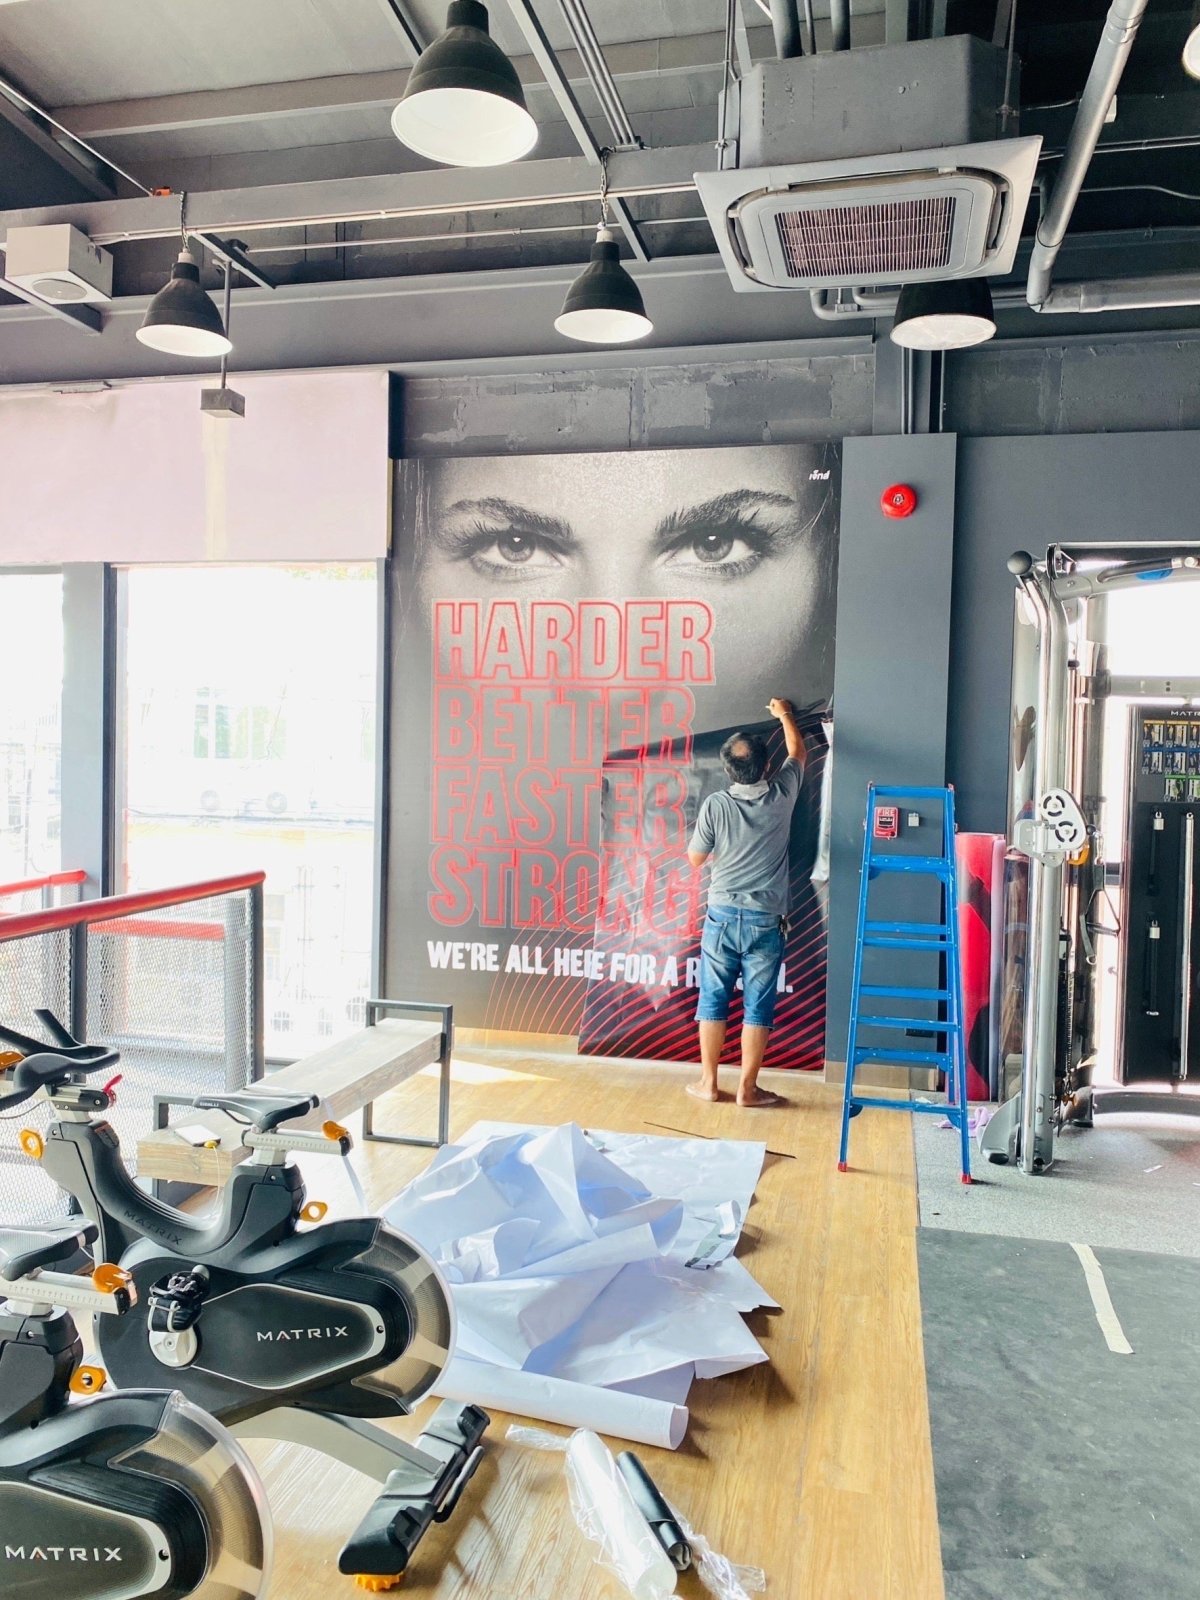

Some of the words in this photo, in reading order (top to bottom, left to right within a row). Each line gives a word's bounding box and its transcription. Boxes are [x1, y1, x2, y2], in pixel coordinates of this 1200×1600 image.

[434, 600, 714, 683] HARDER
[433, 685, 694, 766] BETTER
[431, 766, 688, 849] FASTER
[877, 808, 896, 816] FIRE
[428, 845, 705, 938] STRONG
[426, 940, 500, 972] WE'RE
[504, 944, 548, 975] ALL
[609, 952, 657, 985] FOR
[660, 955, 679, 987] A
[124, 1210, 182, 1245] MATRIX
[256, 1325, 348, 1342] MATRIX
[4, 1544, 122, 1562] MATRIX
